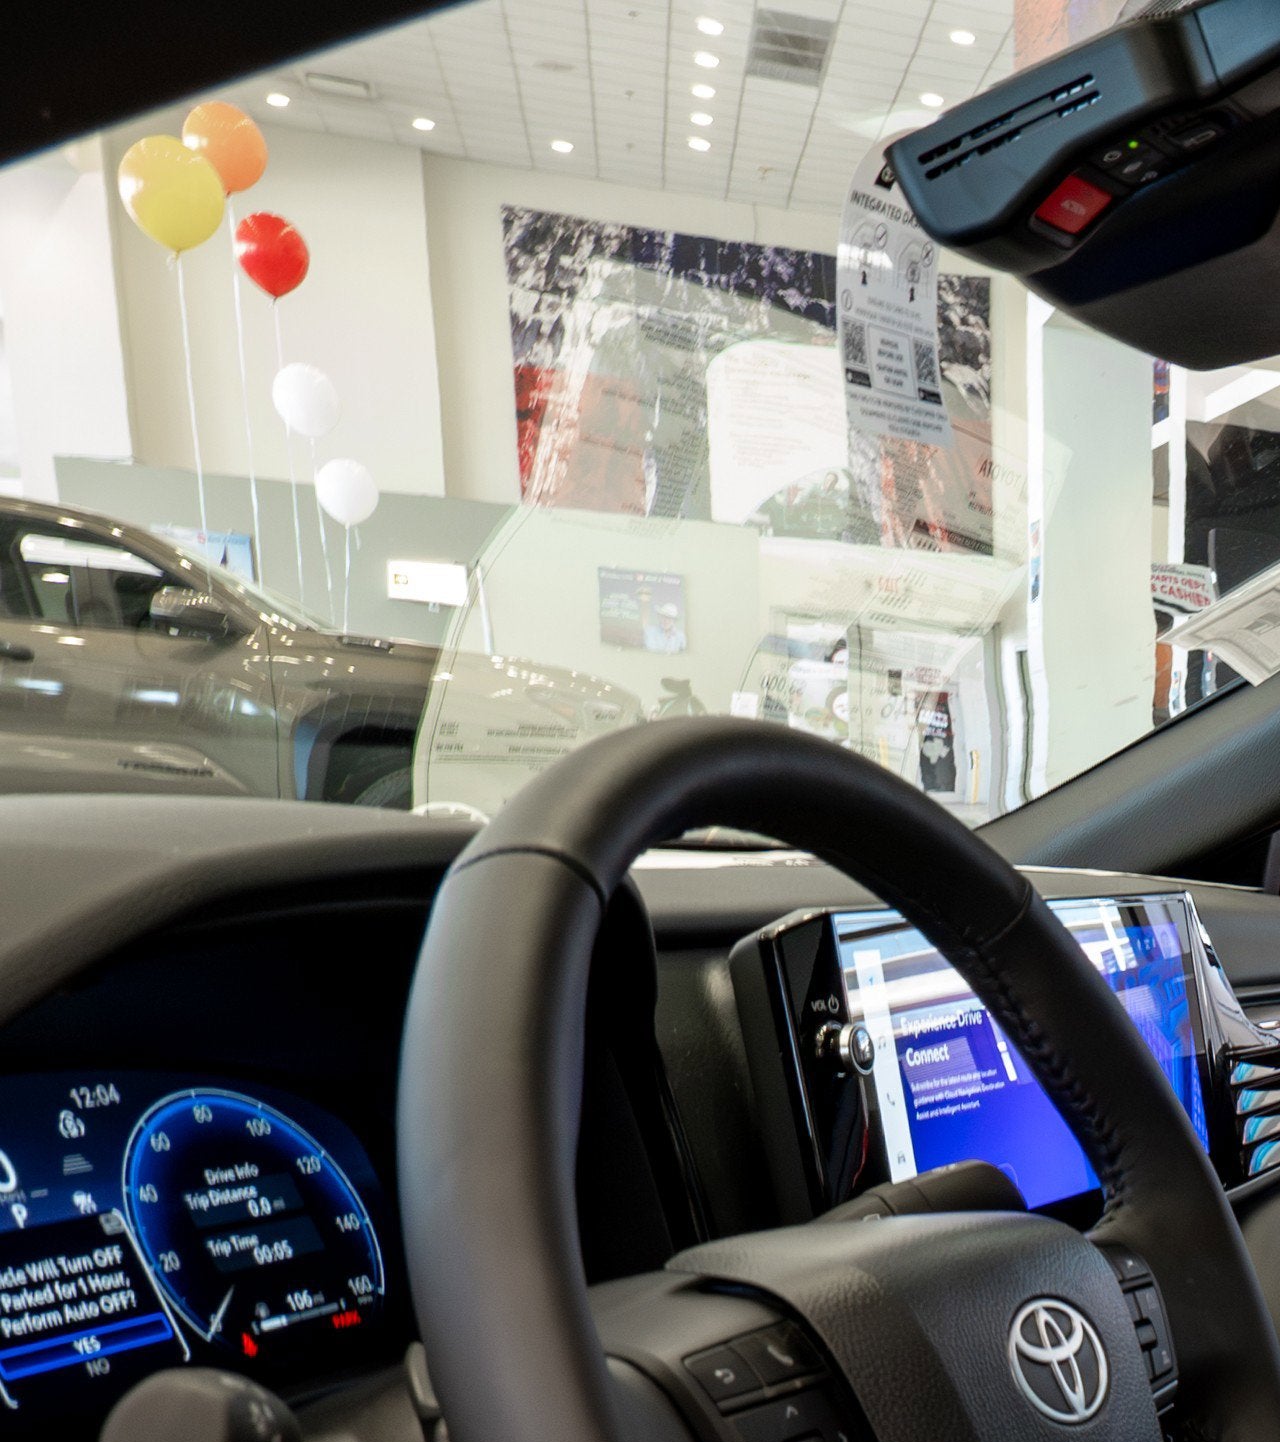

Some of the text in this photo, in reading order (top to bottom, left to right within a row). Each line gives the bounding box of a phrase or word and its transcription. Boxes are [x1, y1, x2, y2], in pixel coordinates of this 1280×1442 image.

[852, 190, 901, 222] INTEGRATED
[1151, 574, 1179, 584] PARTS
[1160, 584, 1211, 607] CASHIER
[901, 1009, 982, 1039] Experience Drive
[906, 1043, 950, 1067] Connect
[70, 1082, 121, 1110] 12:04
[193, 1104, 213, 1124] 80
[246, 1118, 271, 1137] 100
[150, 1131, 171, 1152] 60
[204, 1162, 259, 1186] Drive Info
[296, 1155, 321, 1175] 120
[139, 1183, 158, 1203] 40
[184, 1185, 258, 1212] Trip Distance
[11, 1203, 28, 1229] P
[248, 1196, 271, 1217] 0.0
[335, 1213, 360, 1233] 140
[206, 1234, 260, 1258] Trip Time
[253, 1239, 293, 1265] 00:05
[25, 1258, 60, 1283] Will
[57, 1255, 94, 1276] Turn
[92, 1245, 123, 1268] OFF
[160, 1251, 181, 1273] 20
[0, 1271, 131, 1313] Parked for 1 Hour,
[348, 1274, 372, 1296] 160
[286, 1290, 313, 1312] 106
[0, 1289, 137, 1339] Perform Auto OFF?
[73, 1335, 101, 1355] YES
[85, 1357, 110, 1378] NO
